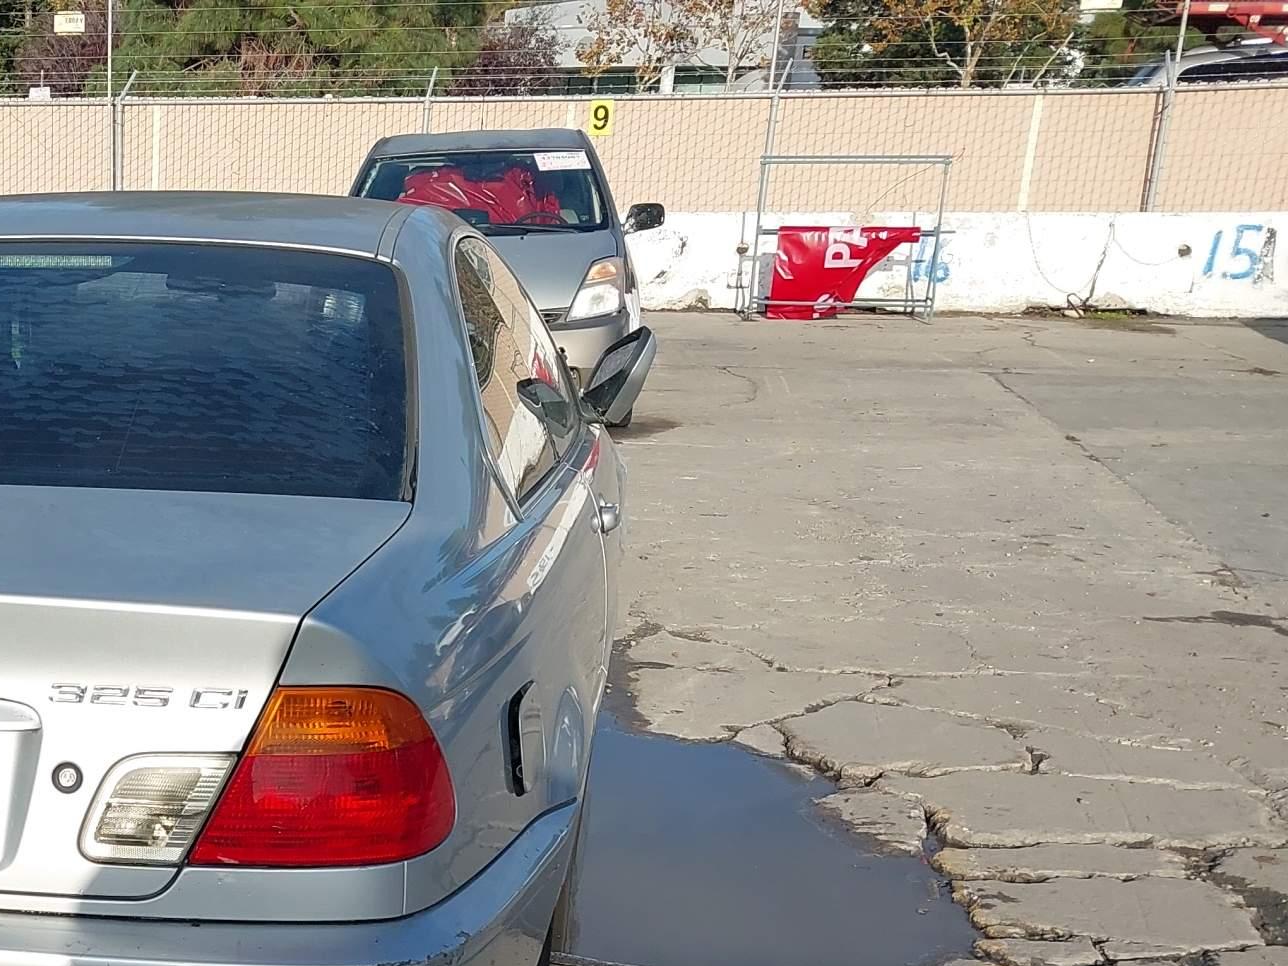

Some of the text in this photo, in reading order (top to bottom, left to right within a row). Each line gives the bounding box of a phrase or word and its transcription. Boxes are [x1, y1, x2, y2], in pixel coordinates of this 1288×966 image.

[593, 105, 609, 130] 9
[1202, 224, 1263, 280] 15
[48, 682, 249, 709] 325 Ci
